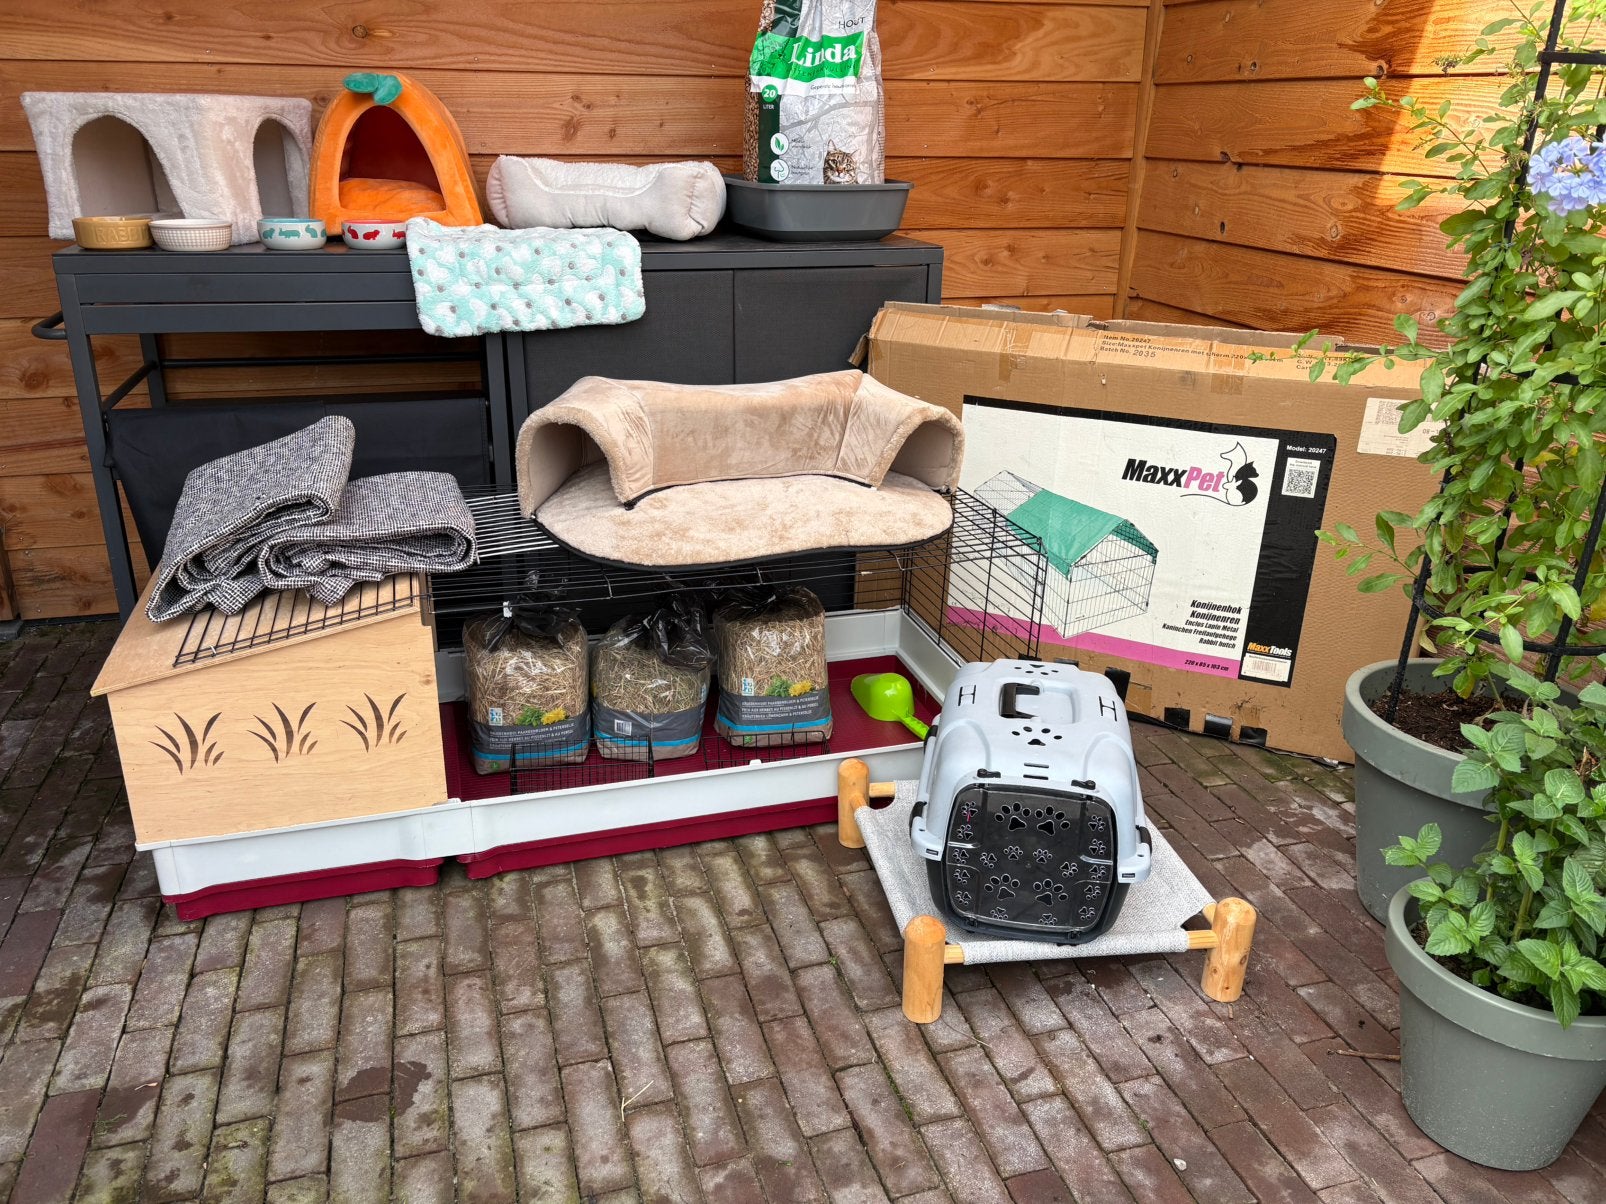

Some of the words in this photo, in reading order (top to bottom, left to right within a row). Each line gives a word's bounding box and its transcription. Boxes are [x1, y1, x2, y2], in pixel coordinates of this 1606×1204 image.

[838, 17, 865, 29] HOUT
[788, 43, 857, 67] Linda
[764, 88, 776, 98] 20
[1132, 349, 1157, 358] 2035
[1121, 458, 1225, 493] MaxxPet
[1190, 599, 1243, 615] Konijnenhok
[1189, 609, 1241, 625] Konijnenren
[1184, 619, 1205, 628] Enclos
[1205, 622, 1221, 630] Lapin
[1161, 623, 1193, 634] Kaninchen
[1193, 628, 1238, 642] Freilaufgehege
[1198, 637, 1219, 647] Rabbit
[1218, 640, 1237, 650] hutch
[1248, 642, 1292, 656] MaxxTools
